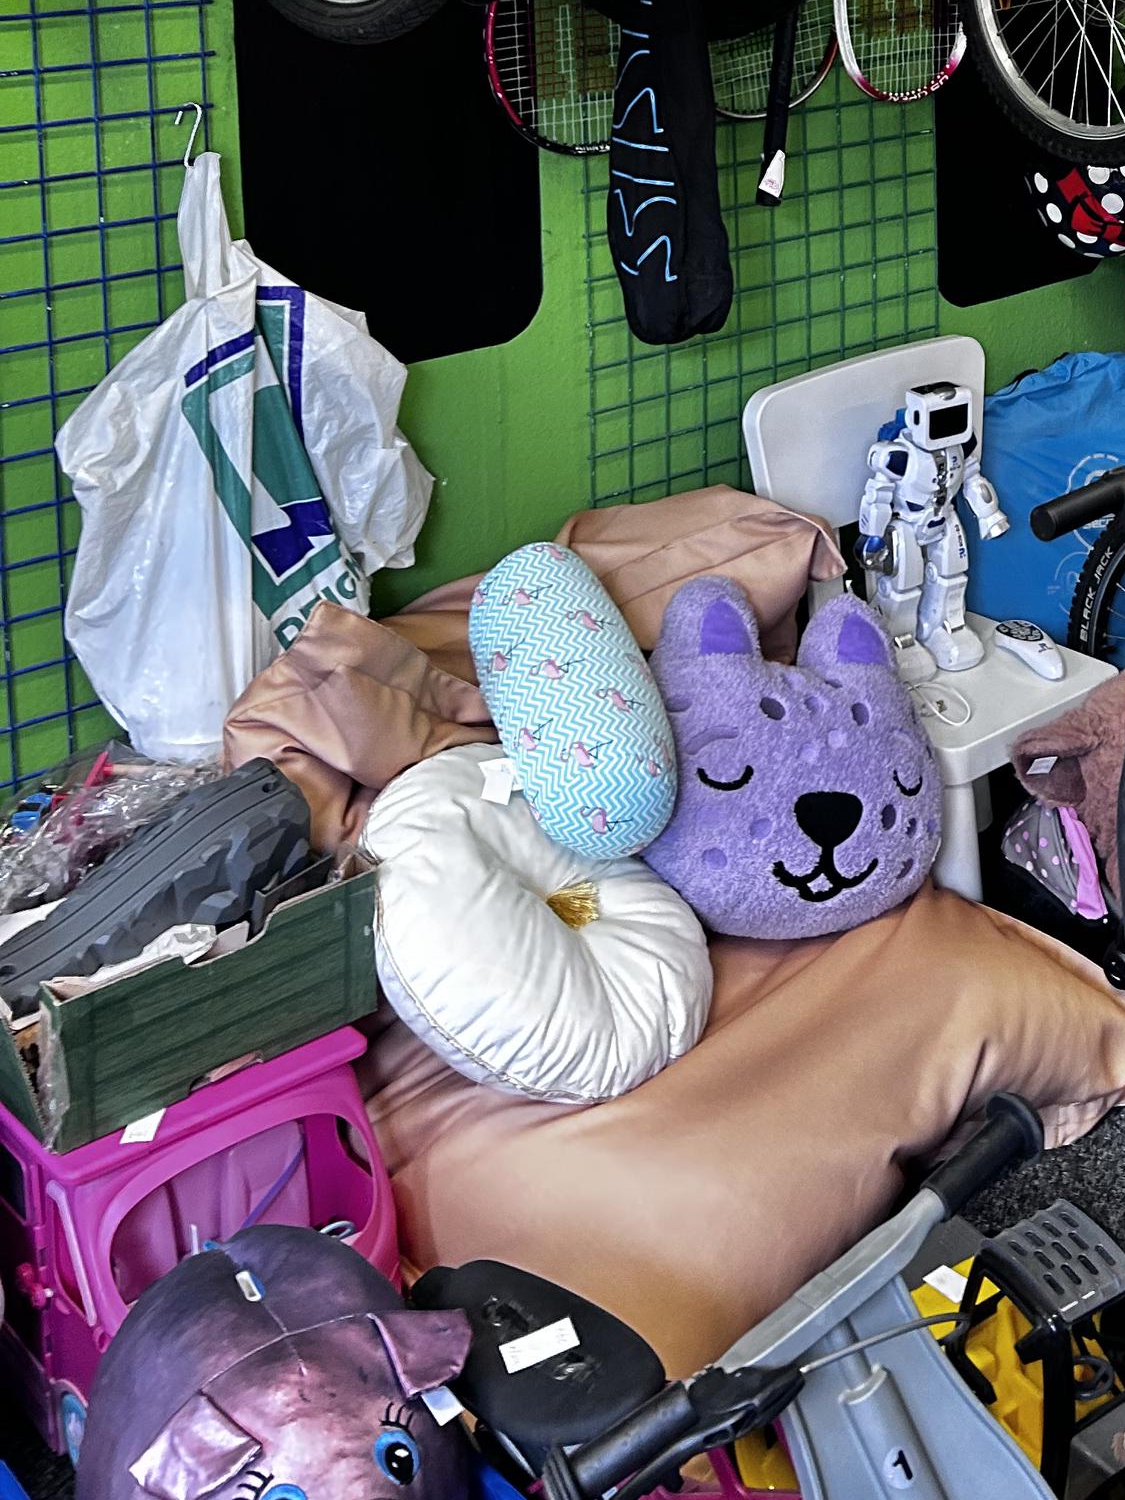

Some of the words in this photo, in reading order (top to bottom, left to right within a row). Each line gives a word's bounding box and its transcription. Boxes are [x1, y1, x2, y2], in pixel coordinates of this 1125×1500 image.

[1078, 585, 1097, 643] BLACK
[1093, 545, 1114, 586] JACK
[892, 1449, 914, 1481] 1
